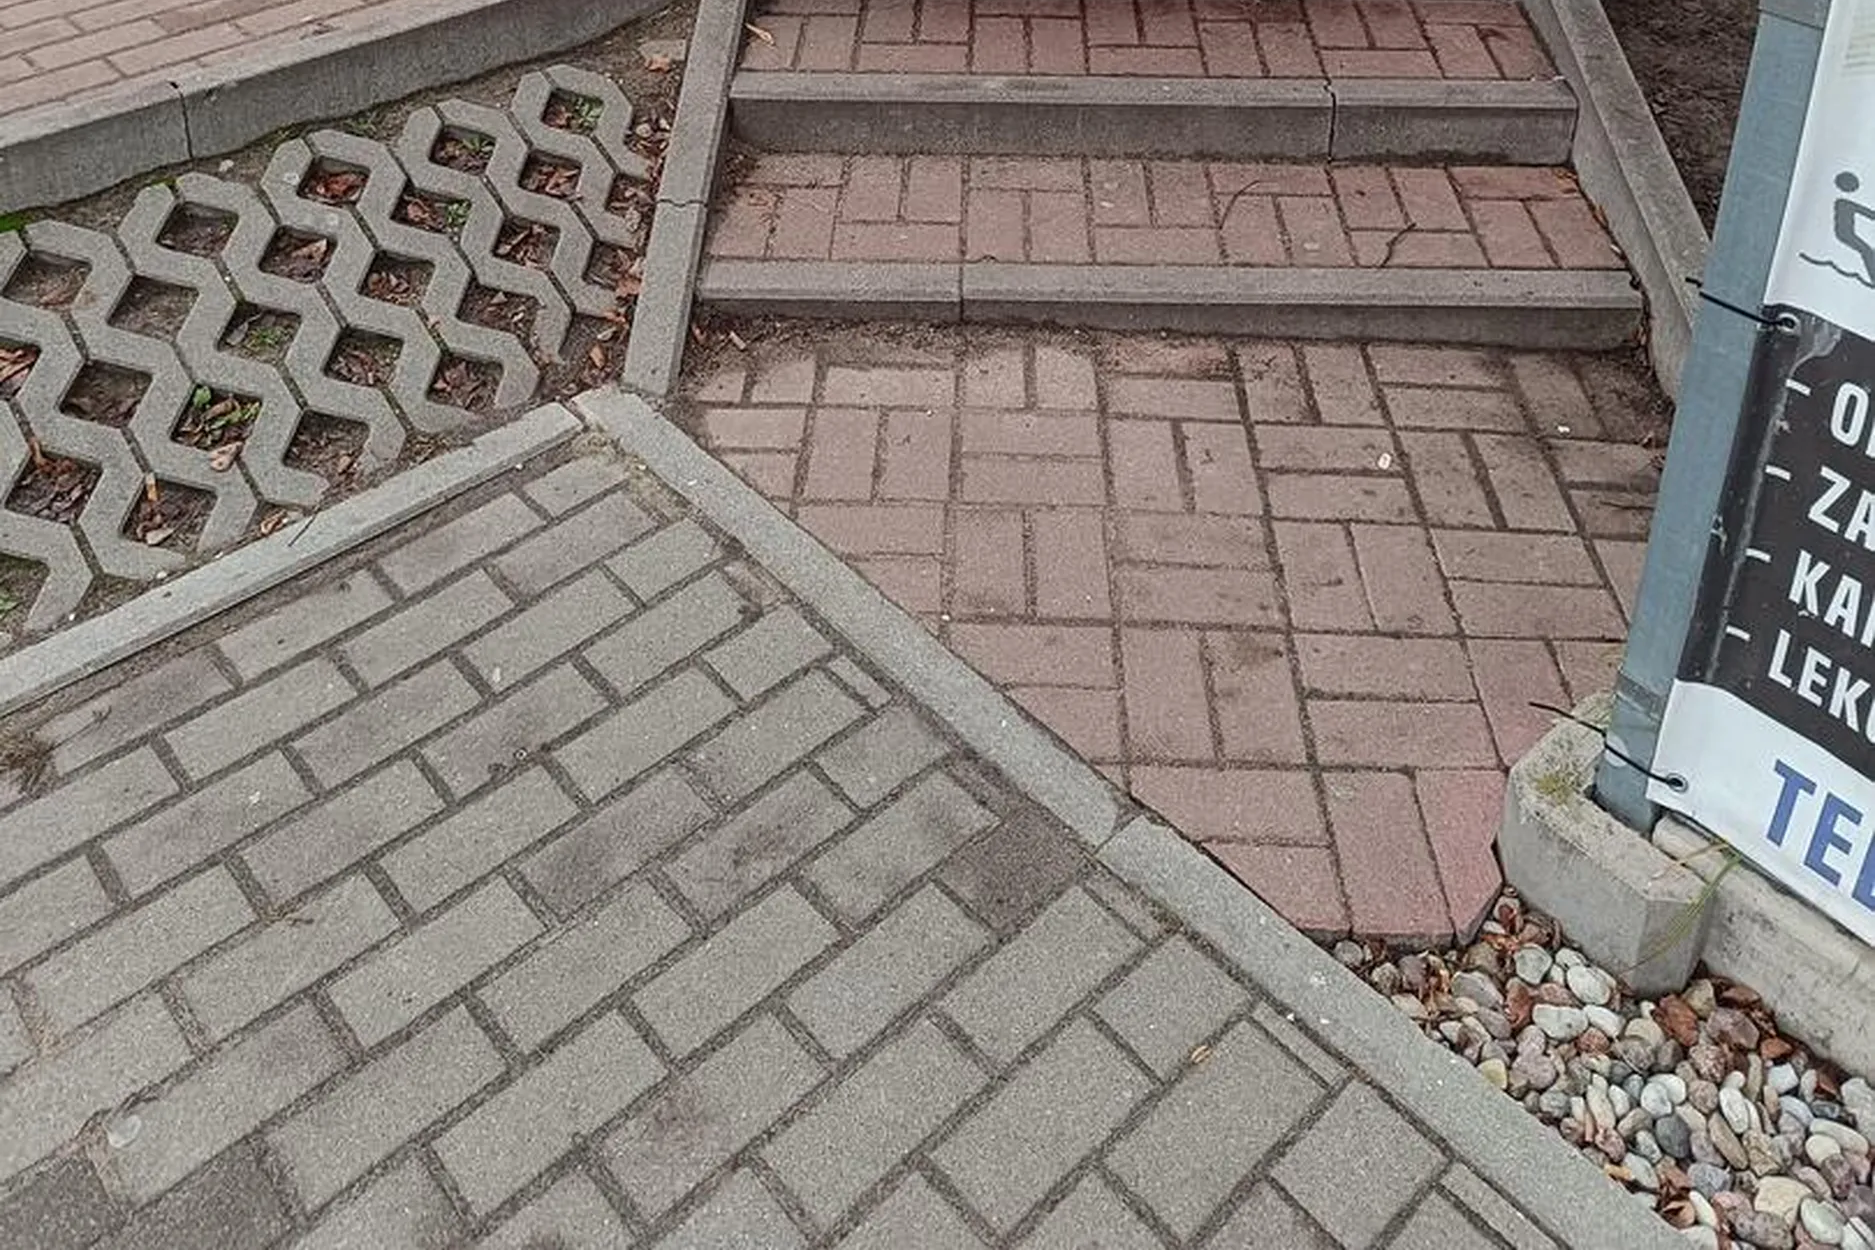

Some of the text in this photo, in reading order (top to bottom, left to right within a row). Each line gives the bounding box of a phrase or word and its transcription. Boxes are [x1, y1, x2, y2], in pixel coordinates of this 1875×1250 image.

[1831, 382, 1875, 458] O
[1789, 549, 1875, 648] KA
[1768, 629, 1875, 744] LEK
